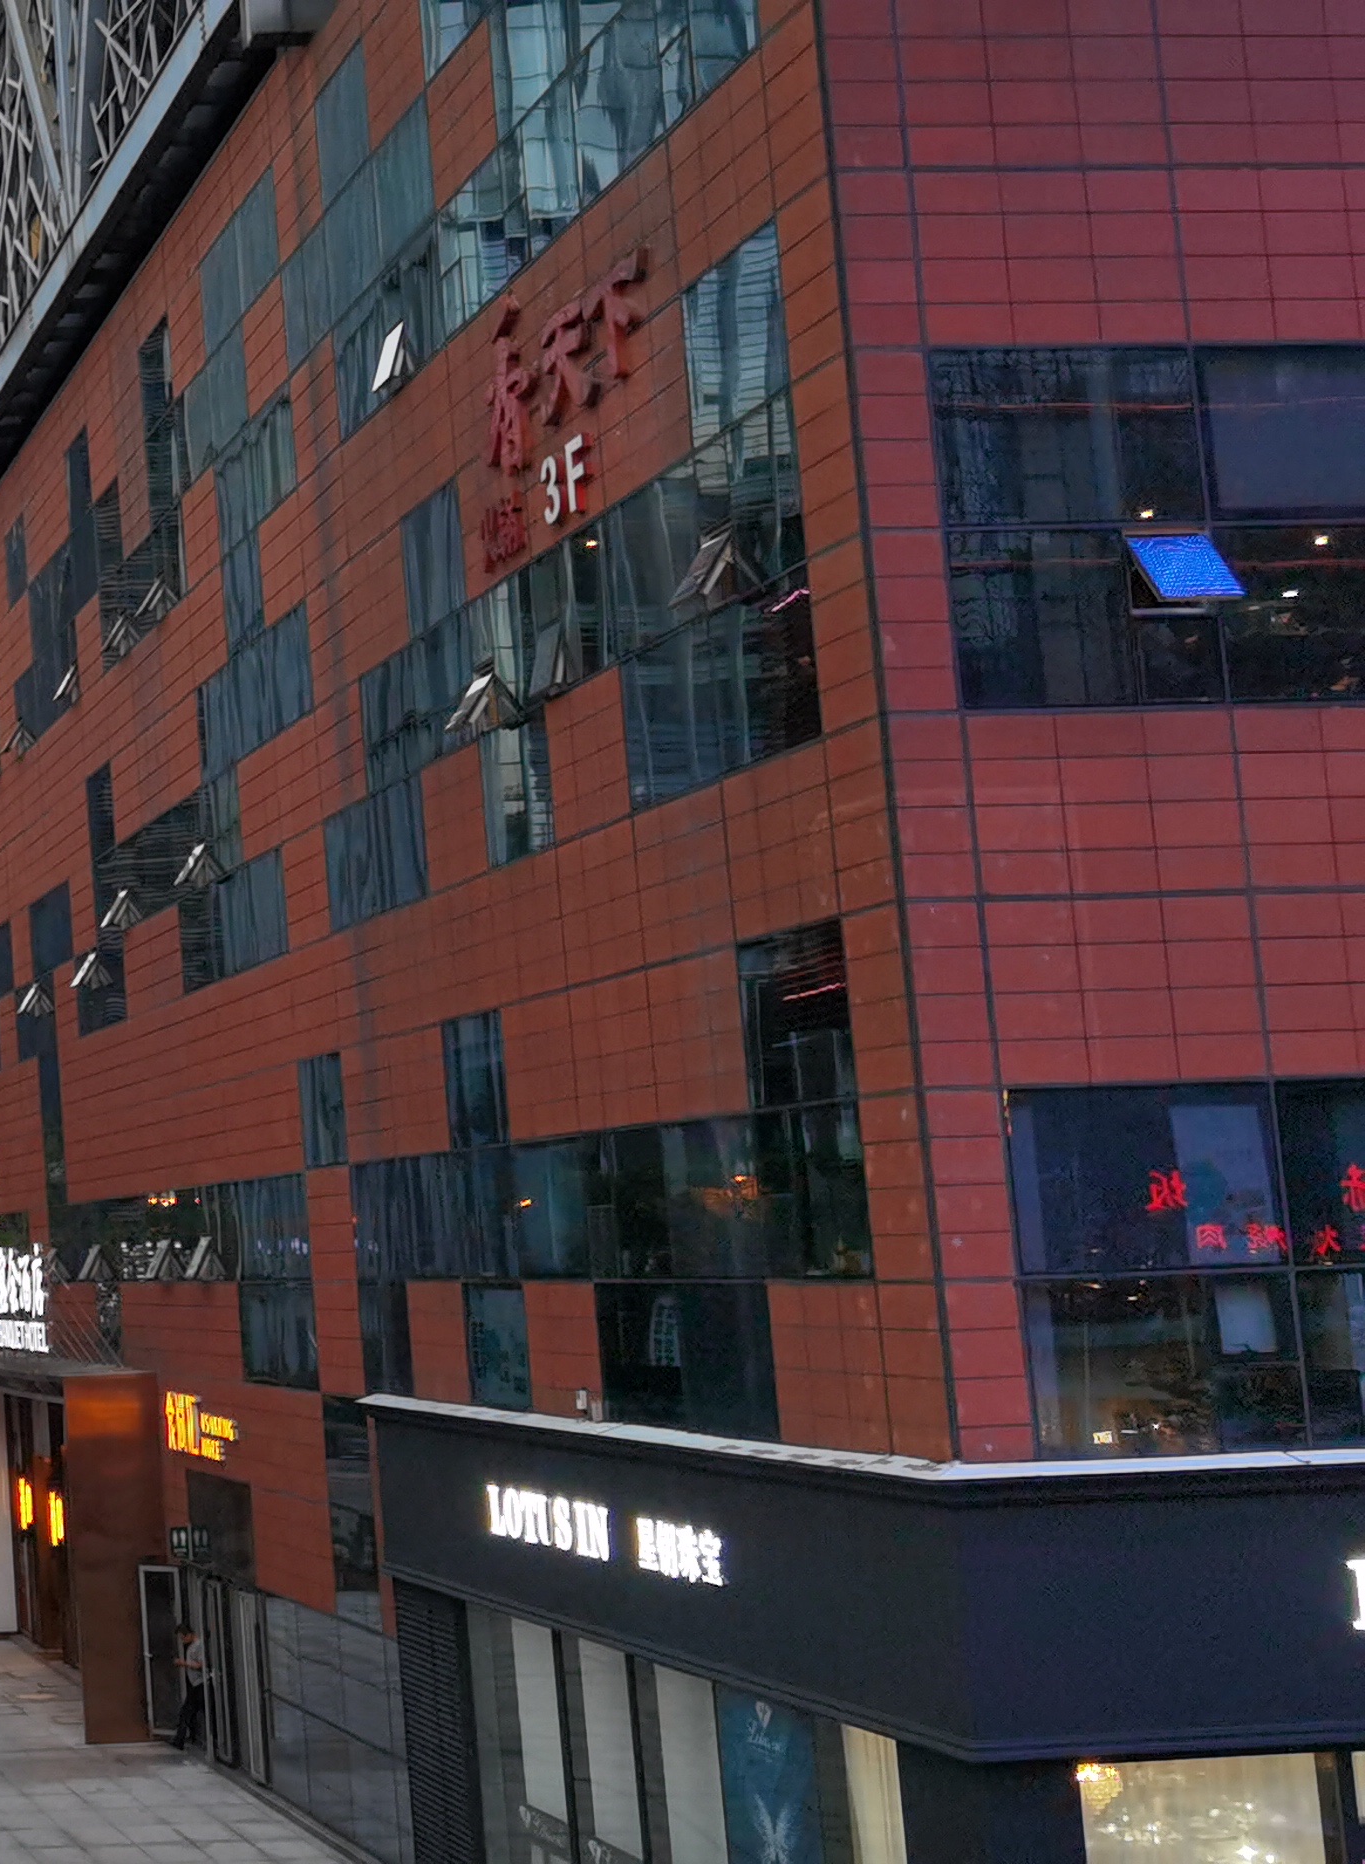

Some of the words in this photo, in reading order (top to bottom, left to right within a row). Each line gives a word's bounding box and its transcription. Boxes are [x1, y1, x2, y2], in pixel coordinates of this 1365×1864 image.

[540, 433, 586, 525] 3F
[485, 1484, 572, 1552] LOTUS
[573, 1501, 610, 1562] IN
